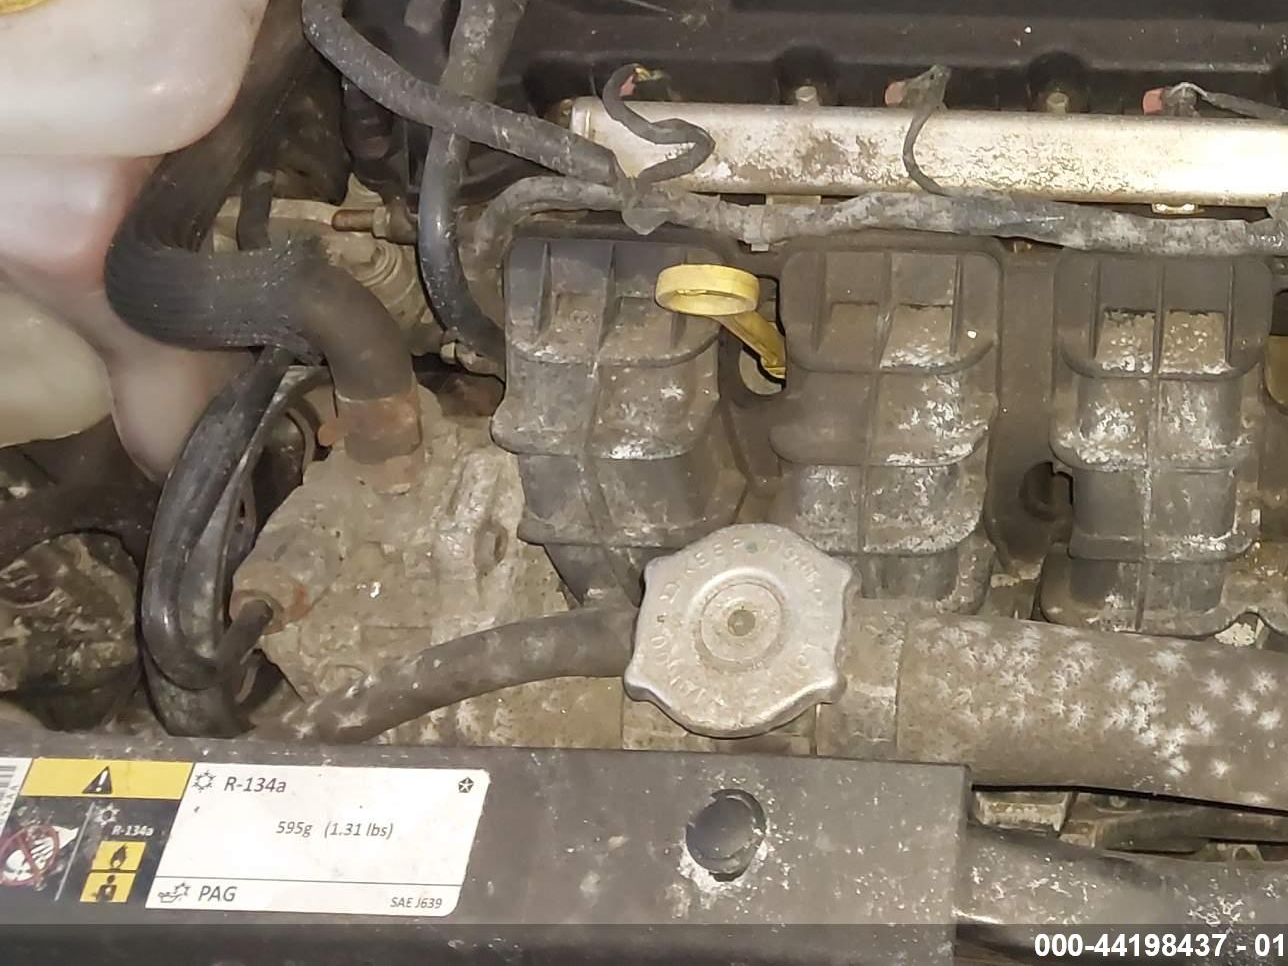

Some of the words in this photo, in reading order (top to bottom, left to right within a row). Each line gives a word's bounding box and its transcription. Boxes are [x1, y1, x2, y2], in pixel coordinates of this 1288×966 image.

[223, 775, 287, 794] R-134a
[111, 824, 154, 837] R-134a
[275, 820, 313, 838] 595g
[323, 821, 363, 839] (1.31
[365, 822, 395, 840] lbs)
[197, 885, 238, 903] PAG
[389, 896, 412, 909] SAE
[413, 897, 443, 910] J639
